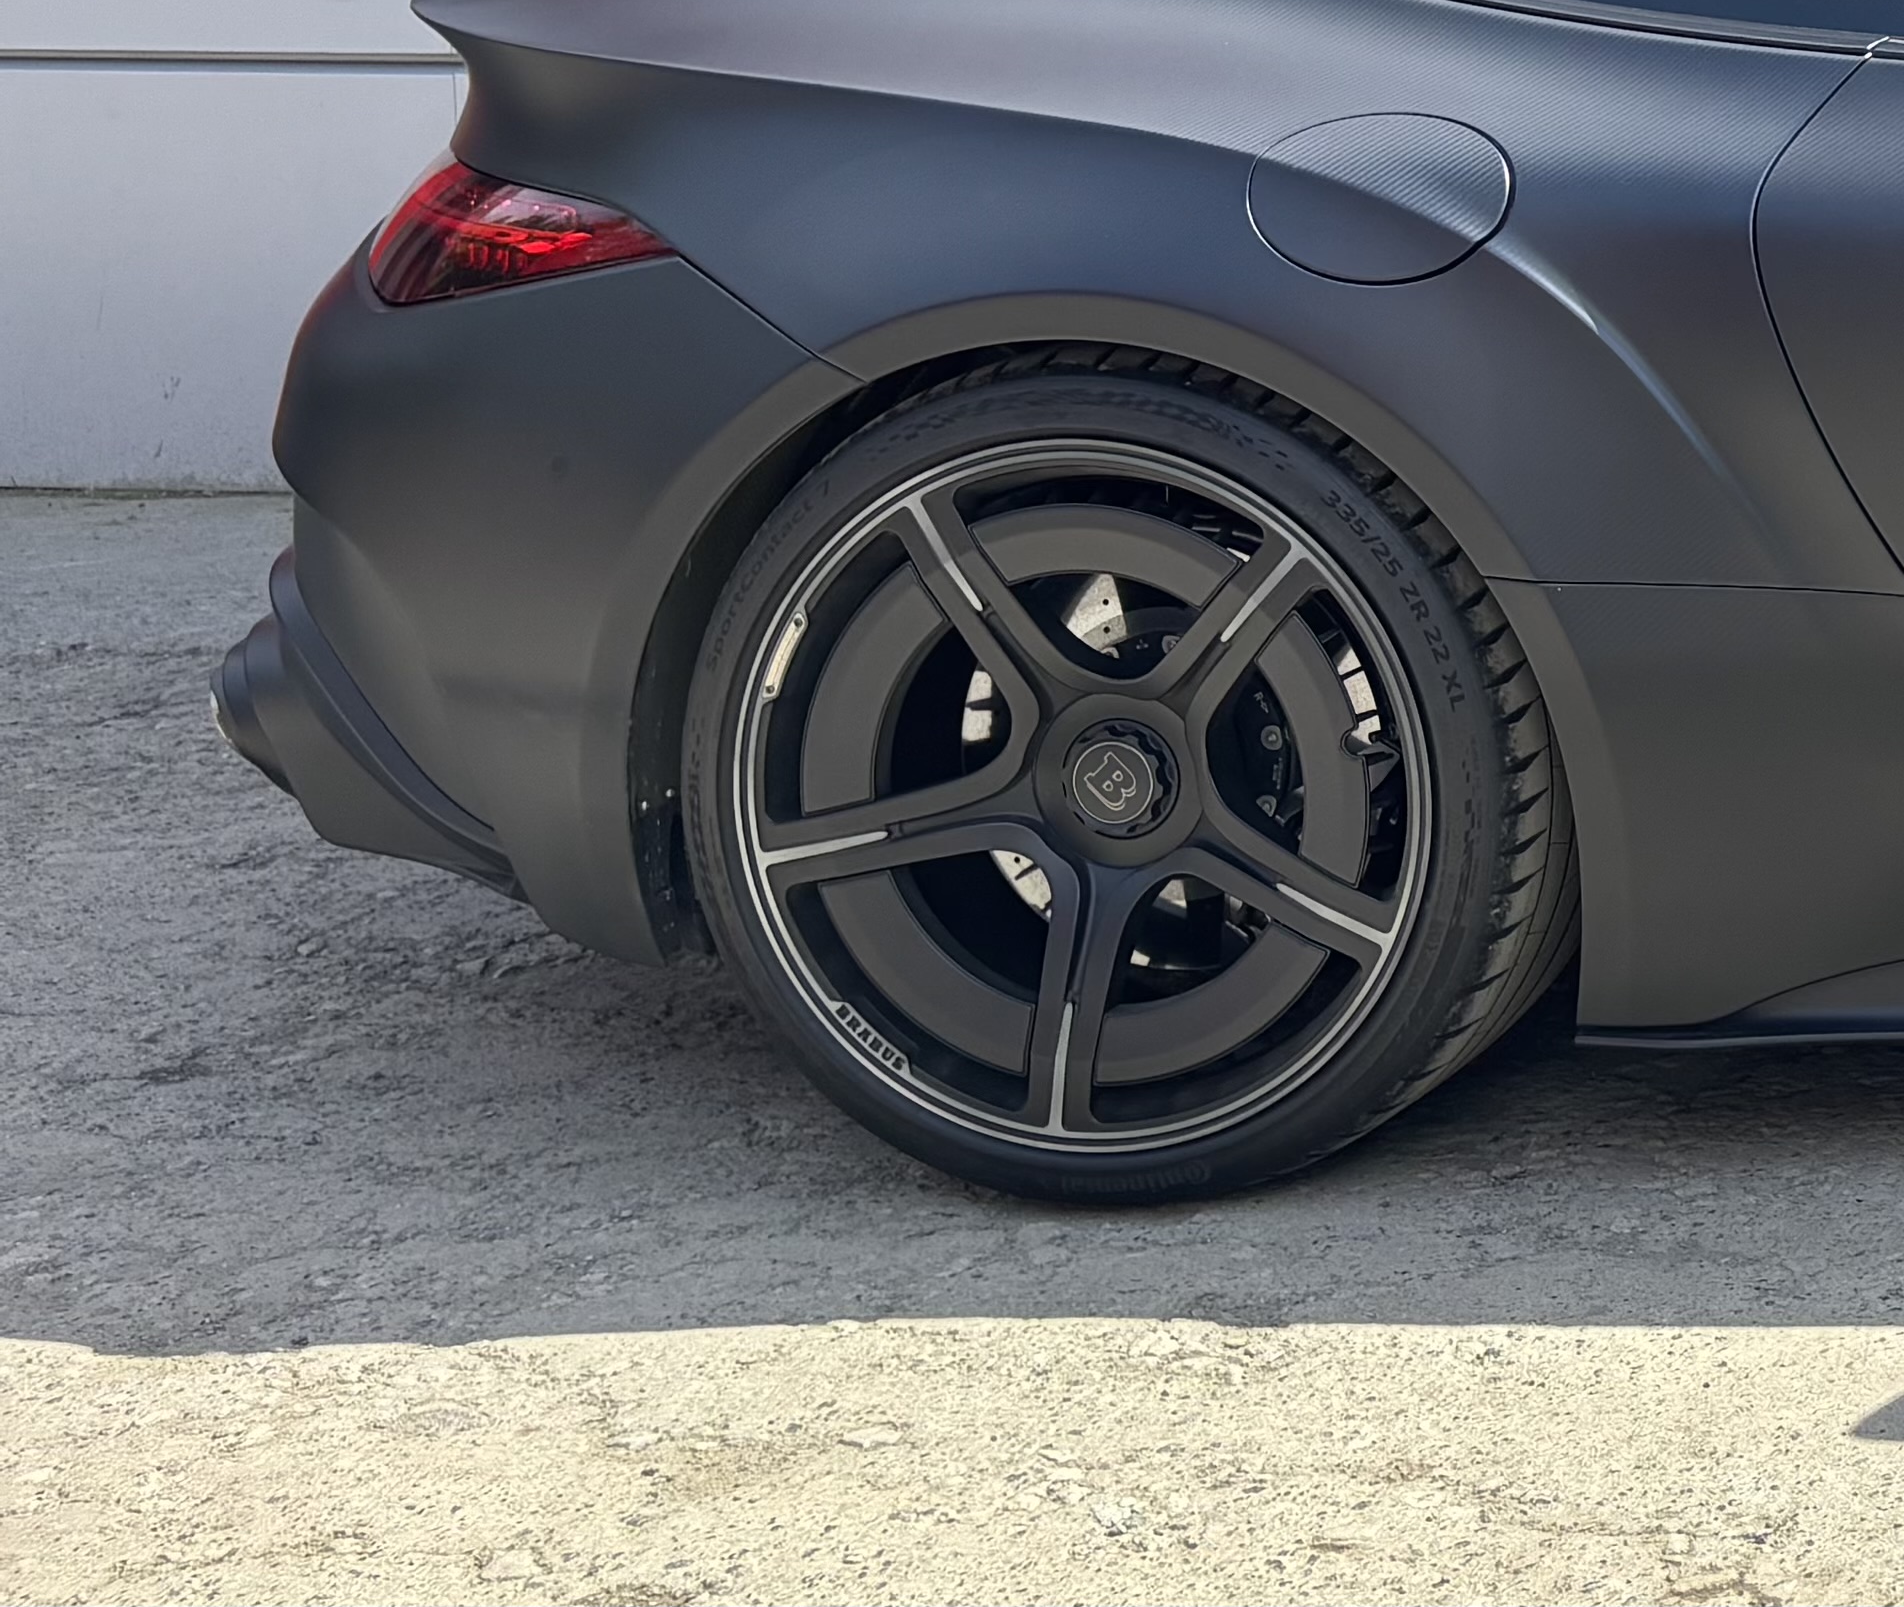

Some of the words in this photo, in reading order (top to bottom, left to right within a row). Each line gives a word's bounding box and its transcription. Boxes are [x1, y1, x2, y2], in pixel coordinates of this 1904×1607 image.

[705, 500, 814, 673] SportContact
[816, 478, 830, 497] 7
[1322, 488, 1404, 579] 335/25
[1399, 580, 1430, 622] ZR
[1423, 625, 1451, 665] 22
[1440, 667, 1467, 713] XL
[1082, 750, 1138, 812] B
[835, 1003, 906, 1071] BRABUS
